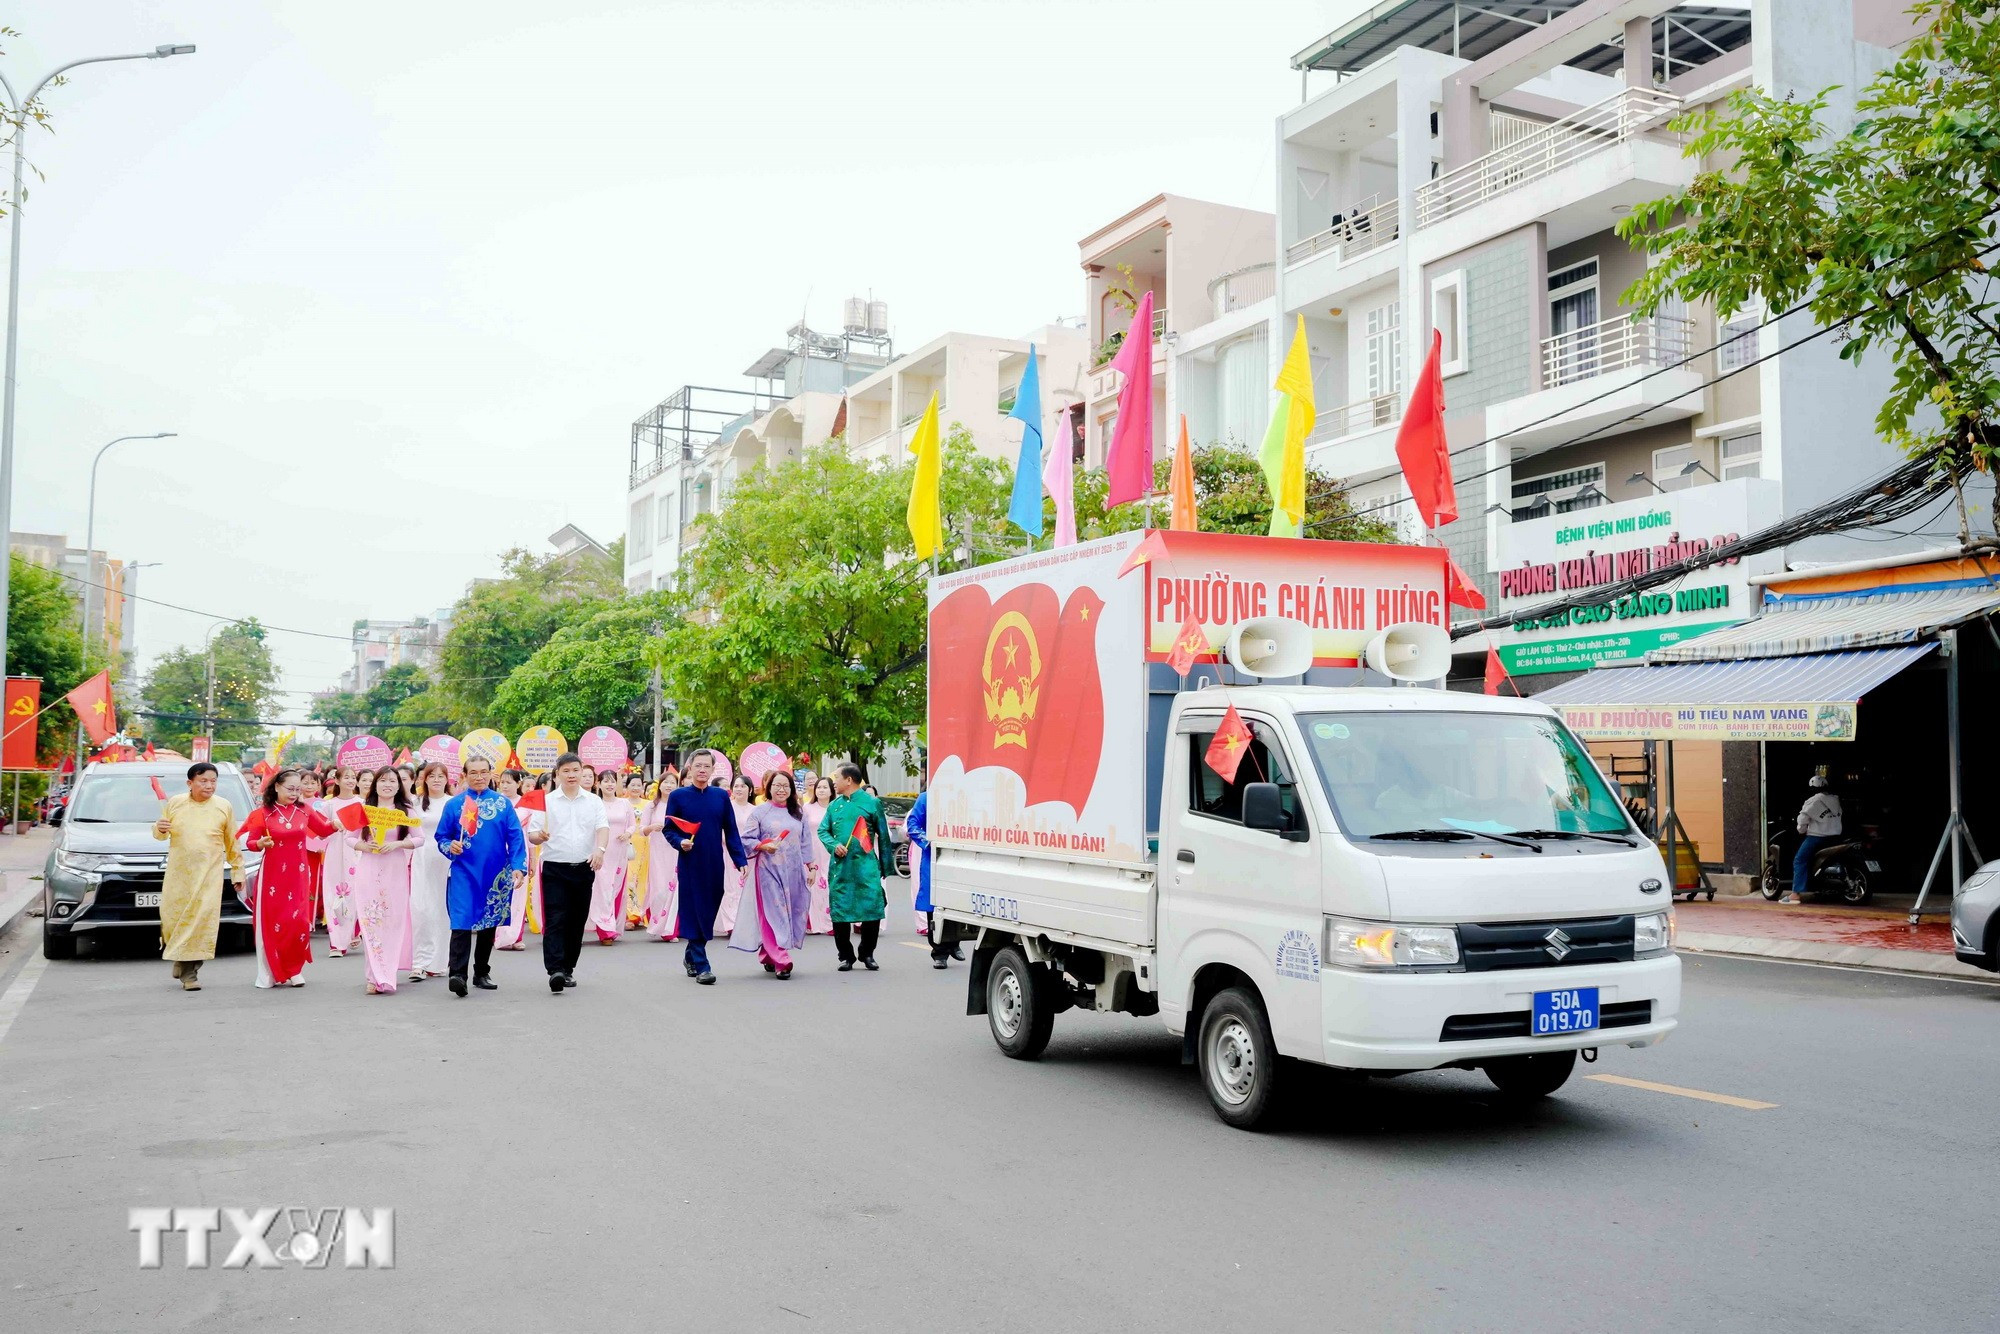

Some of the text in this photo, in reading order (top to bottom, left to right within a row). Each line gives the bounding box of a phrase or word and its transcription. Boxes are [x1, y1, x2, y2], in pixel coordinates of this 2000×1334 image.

[1556, 508, 1671, 545] BỆNH VIỆN NHI ĐỒNG
[1500, 560, 1556, 598] PHÒNG
[1558, 550, 1614, 590] KHÁM
[1157, 571, 1440, 631] PHƯỜNG CHÁNH HƯNG
[1571, 602, 1612, 624] CAO
[1676, 584, 1729, 612] MINH
[1566, 708, 1674, 730] HAI PHƯƠNG
[1678, 706, 1808, 720] HỦ TIẾU NAM VANG
[937, 822, 1105, 852] LÀ NGÀY HỘI CỦA TOÀN DÂN!
[1551, 990, 1580, 1011] 50A
[1539, 1010, 1592, 1032] 019.70
